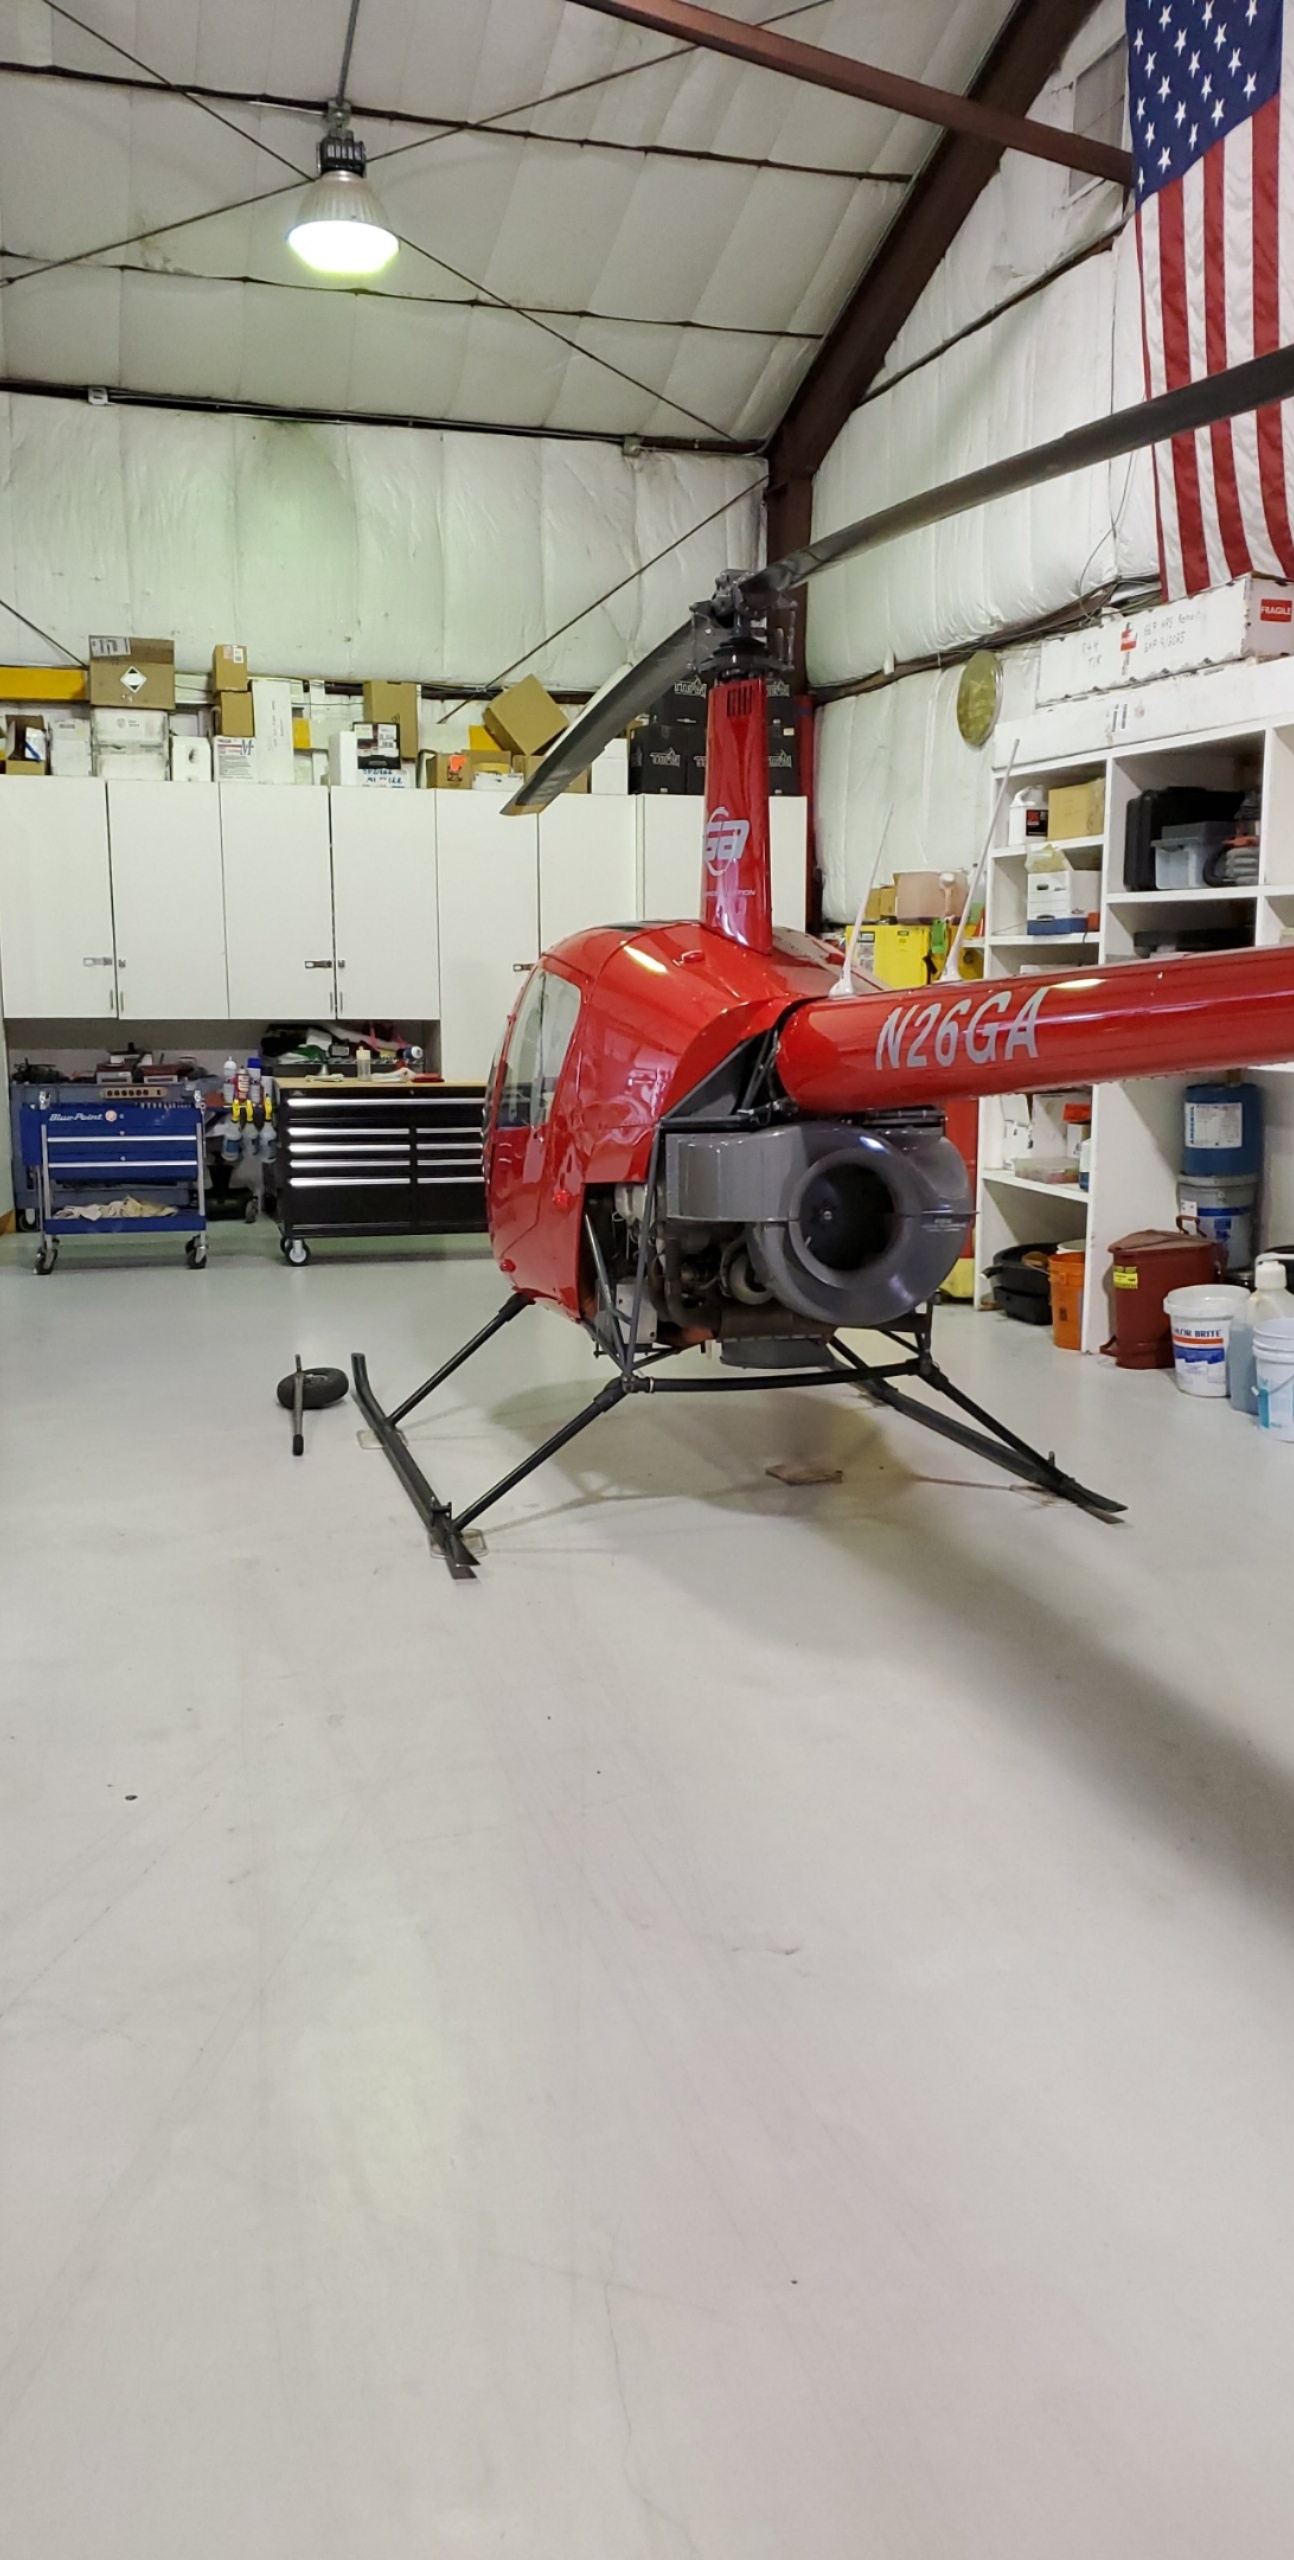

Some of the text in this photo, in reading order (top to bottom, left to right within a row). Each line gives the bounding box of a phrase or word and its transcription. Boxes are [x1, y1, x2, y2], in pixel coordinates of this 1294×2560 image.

[1261, 605, 1292, 616] FRAGILE
[875, 986, 1050, 1070] N26GA
[1194, 1329, 1222, 1338] BRITE
